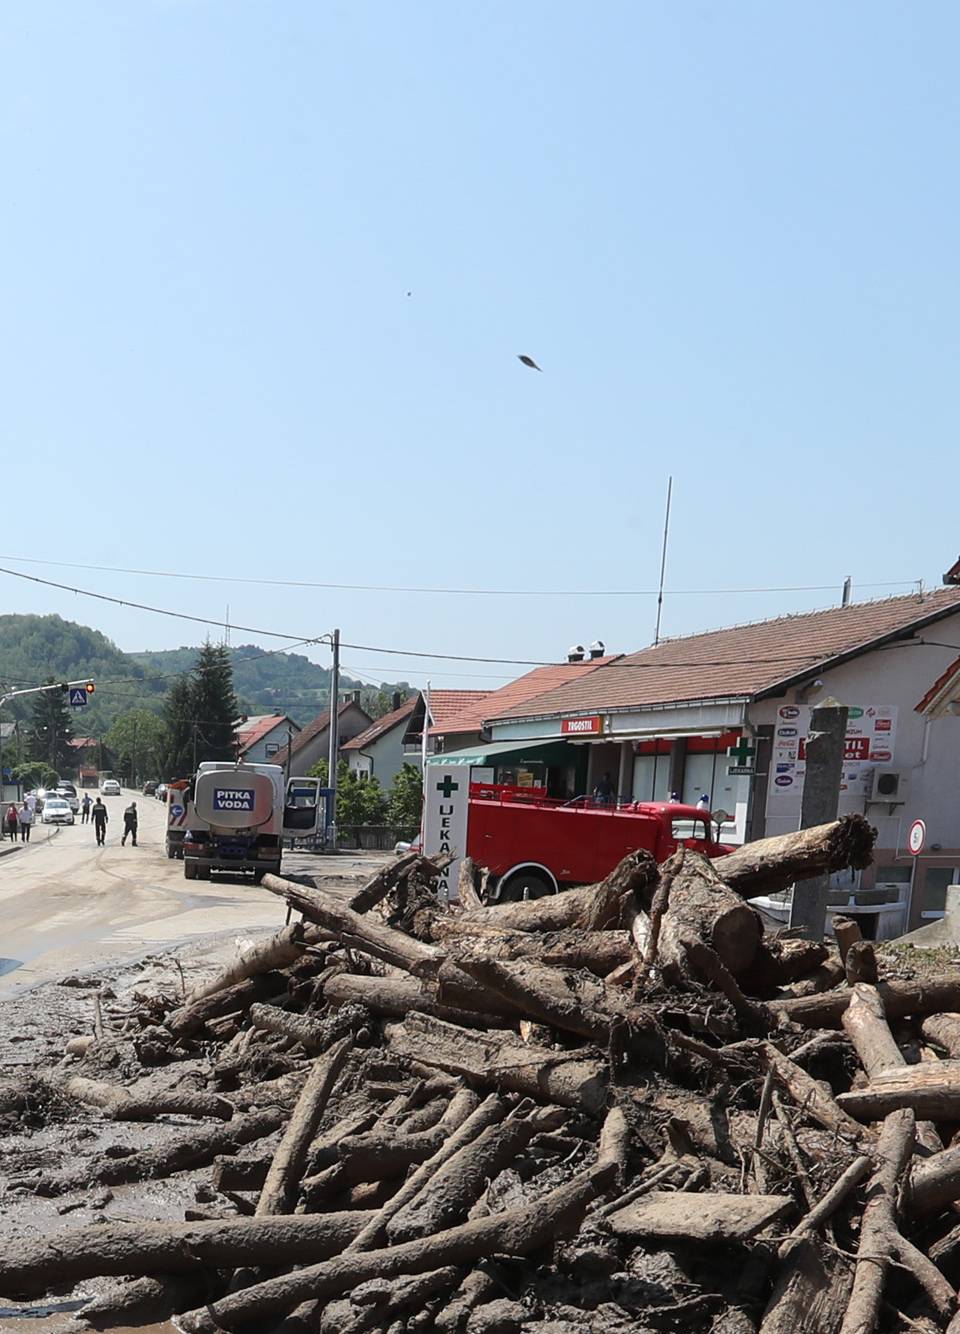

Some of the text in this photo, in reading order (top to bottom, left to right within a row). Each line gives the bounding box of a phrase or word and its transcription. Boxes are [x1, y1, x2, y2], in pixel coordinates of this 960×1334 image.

[216, 790, 251, 800] PITKA
[217, 800, 250, 809] VODA
[438, 805, 454, 890] LJEKANA
